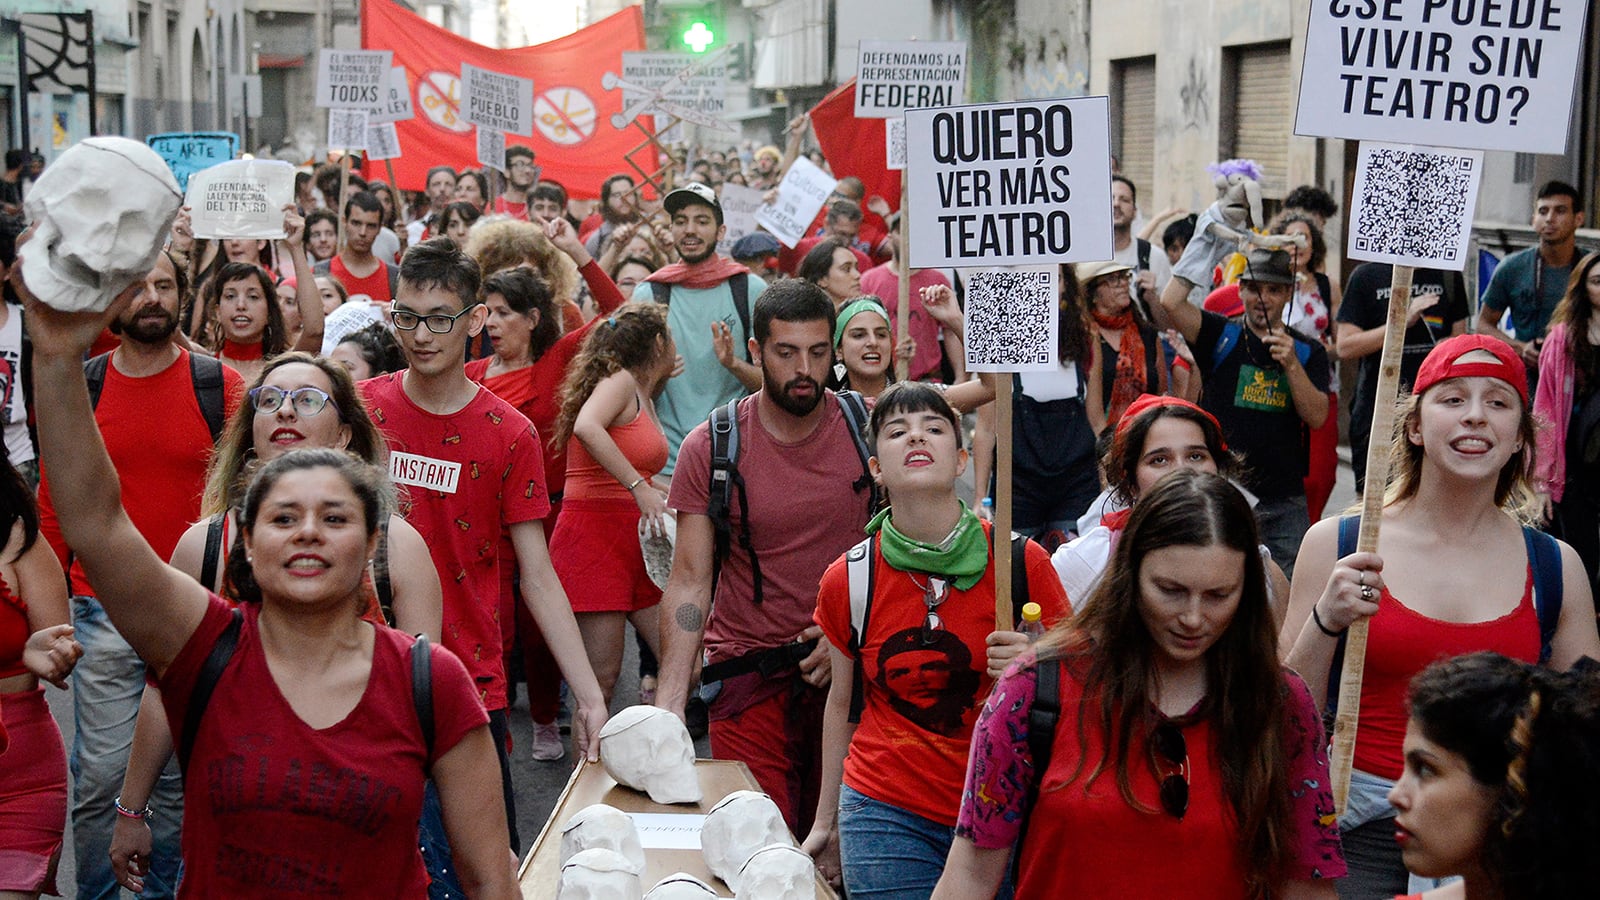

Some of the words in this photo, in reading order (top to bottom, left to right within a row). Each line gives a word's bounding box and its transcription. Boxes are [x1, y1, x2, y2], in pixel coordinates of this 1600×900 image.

[863, 52, 943, 65] DEFENDAMOS
[947, 54, 961, 66] LA
[1340, 26, 1452, 73] VIVIR
[1468, 35, 1543, 79] SIN
[862, 67, 960, 81] REPRESENTACIÓN
[330, 85, 379, 102] TODXS
[1340, 74, 1530, 126] TEATRO?
[387, 100, 408, 114] LEY
[470, 96, 519, 121] PUEBLO
[470, 112, 519, 132] ARGENTINO
[932, 105, 1073, 165] QUIERO
[160, 142, 173, 153] EL
[179, 142, 214, 158] ARTE
[788, 169, 826, 200] Cultura
[937, 170, 992, 208] VER
[1000, 159, 1071, 205] MÁS
[207, 201, 224, 211] DEL
[217, 192, 231, 200] LEY
[763, 204, 804, 235] DERECHO
[784, 202, 797, 216] UN
[938, 210, 1071, 258] TEATRO
[393, 456, 456, 487] INSTANT
